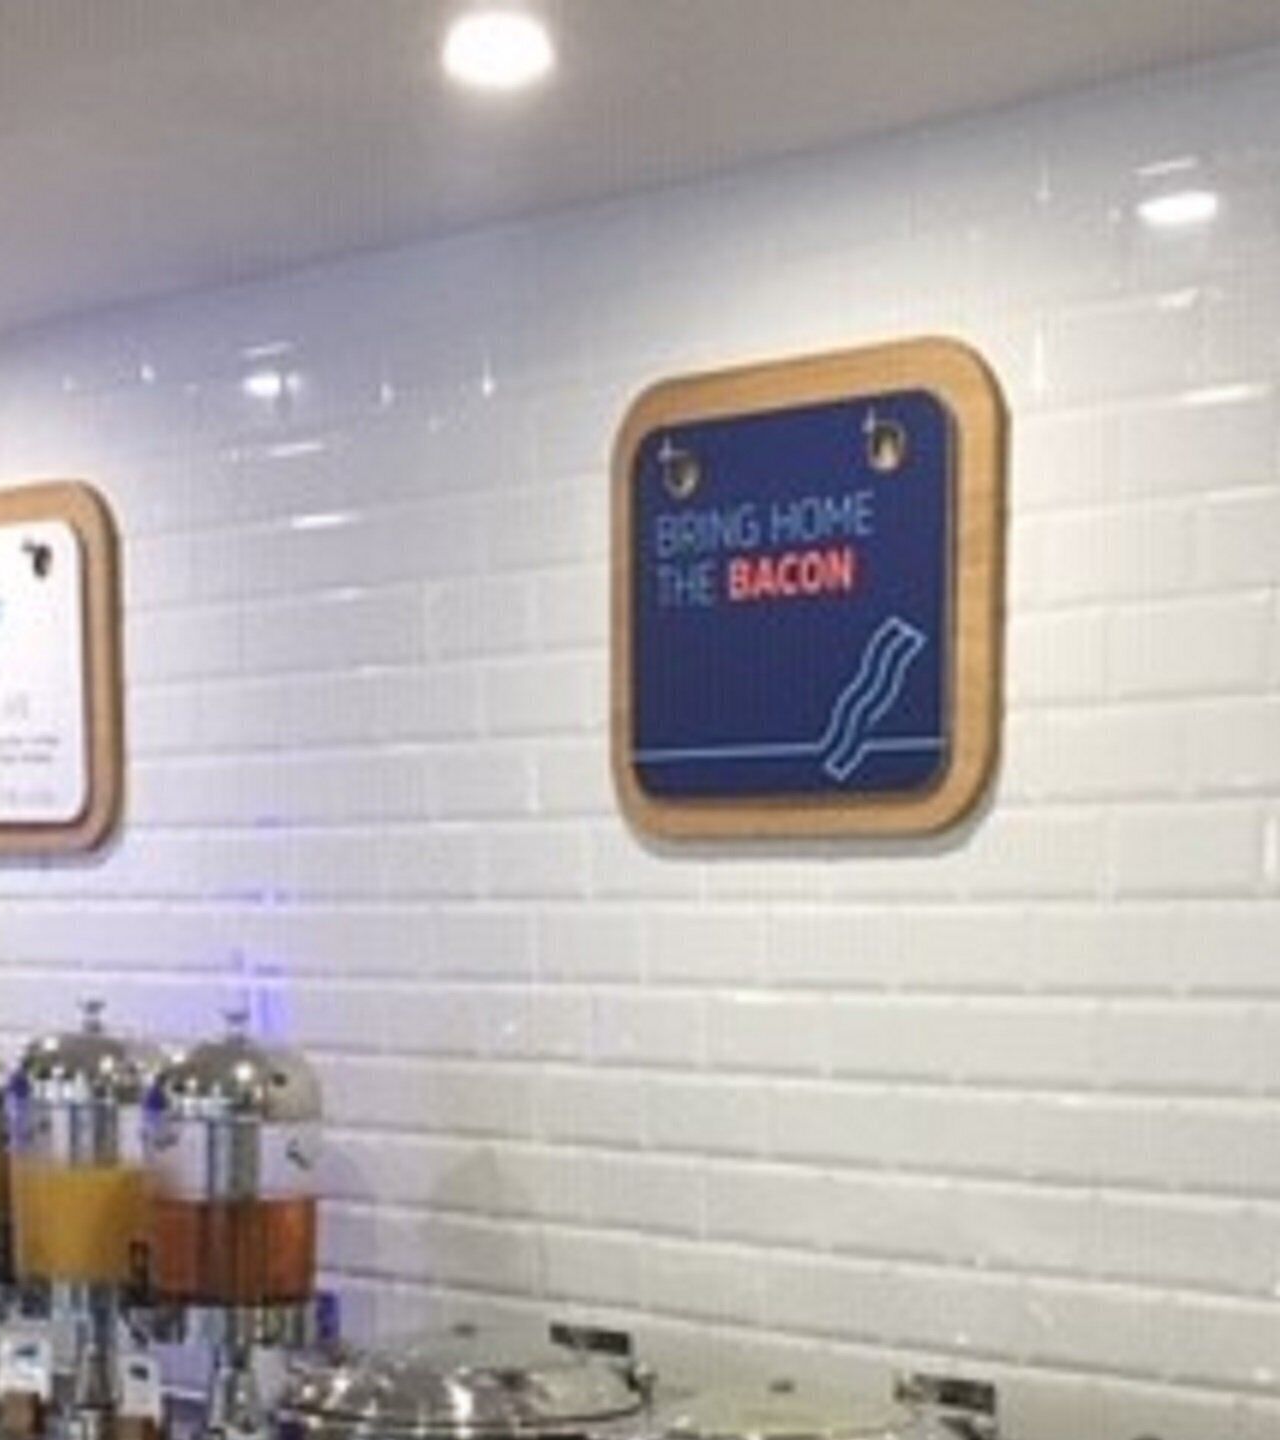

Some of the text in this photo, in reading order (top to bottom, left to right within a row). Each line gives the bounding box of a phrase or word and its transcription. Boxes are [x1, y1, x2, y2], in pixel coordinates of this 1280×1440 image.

[656, 489, 875, 559] BRING HOME
[656, 546, 853, 607] THE BACON
